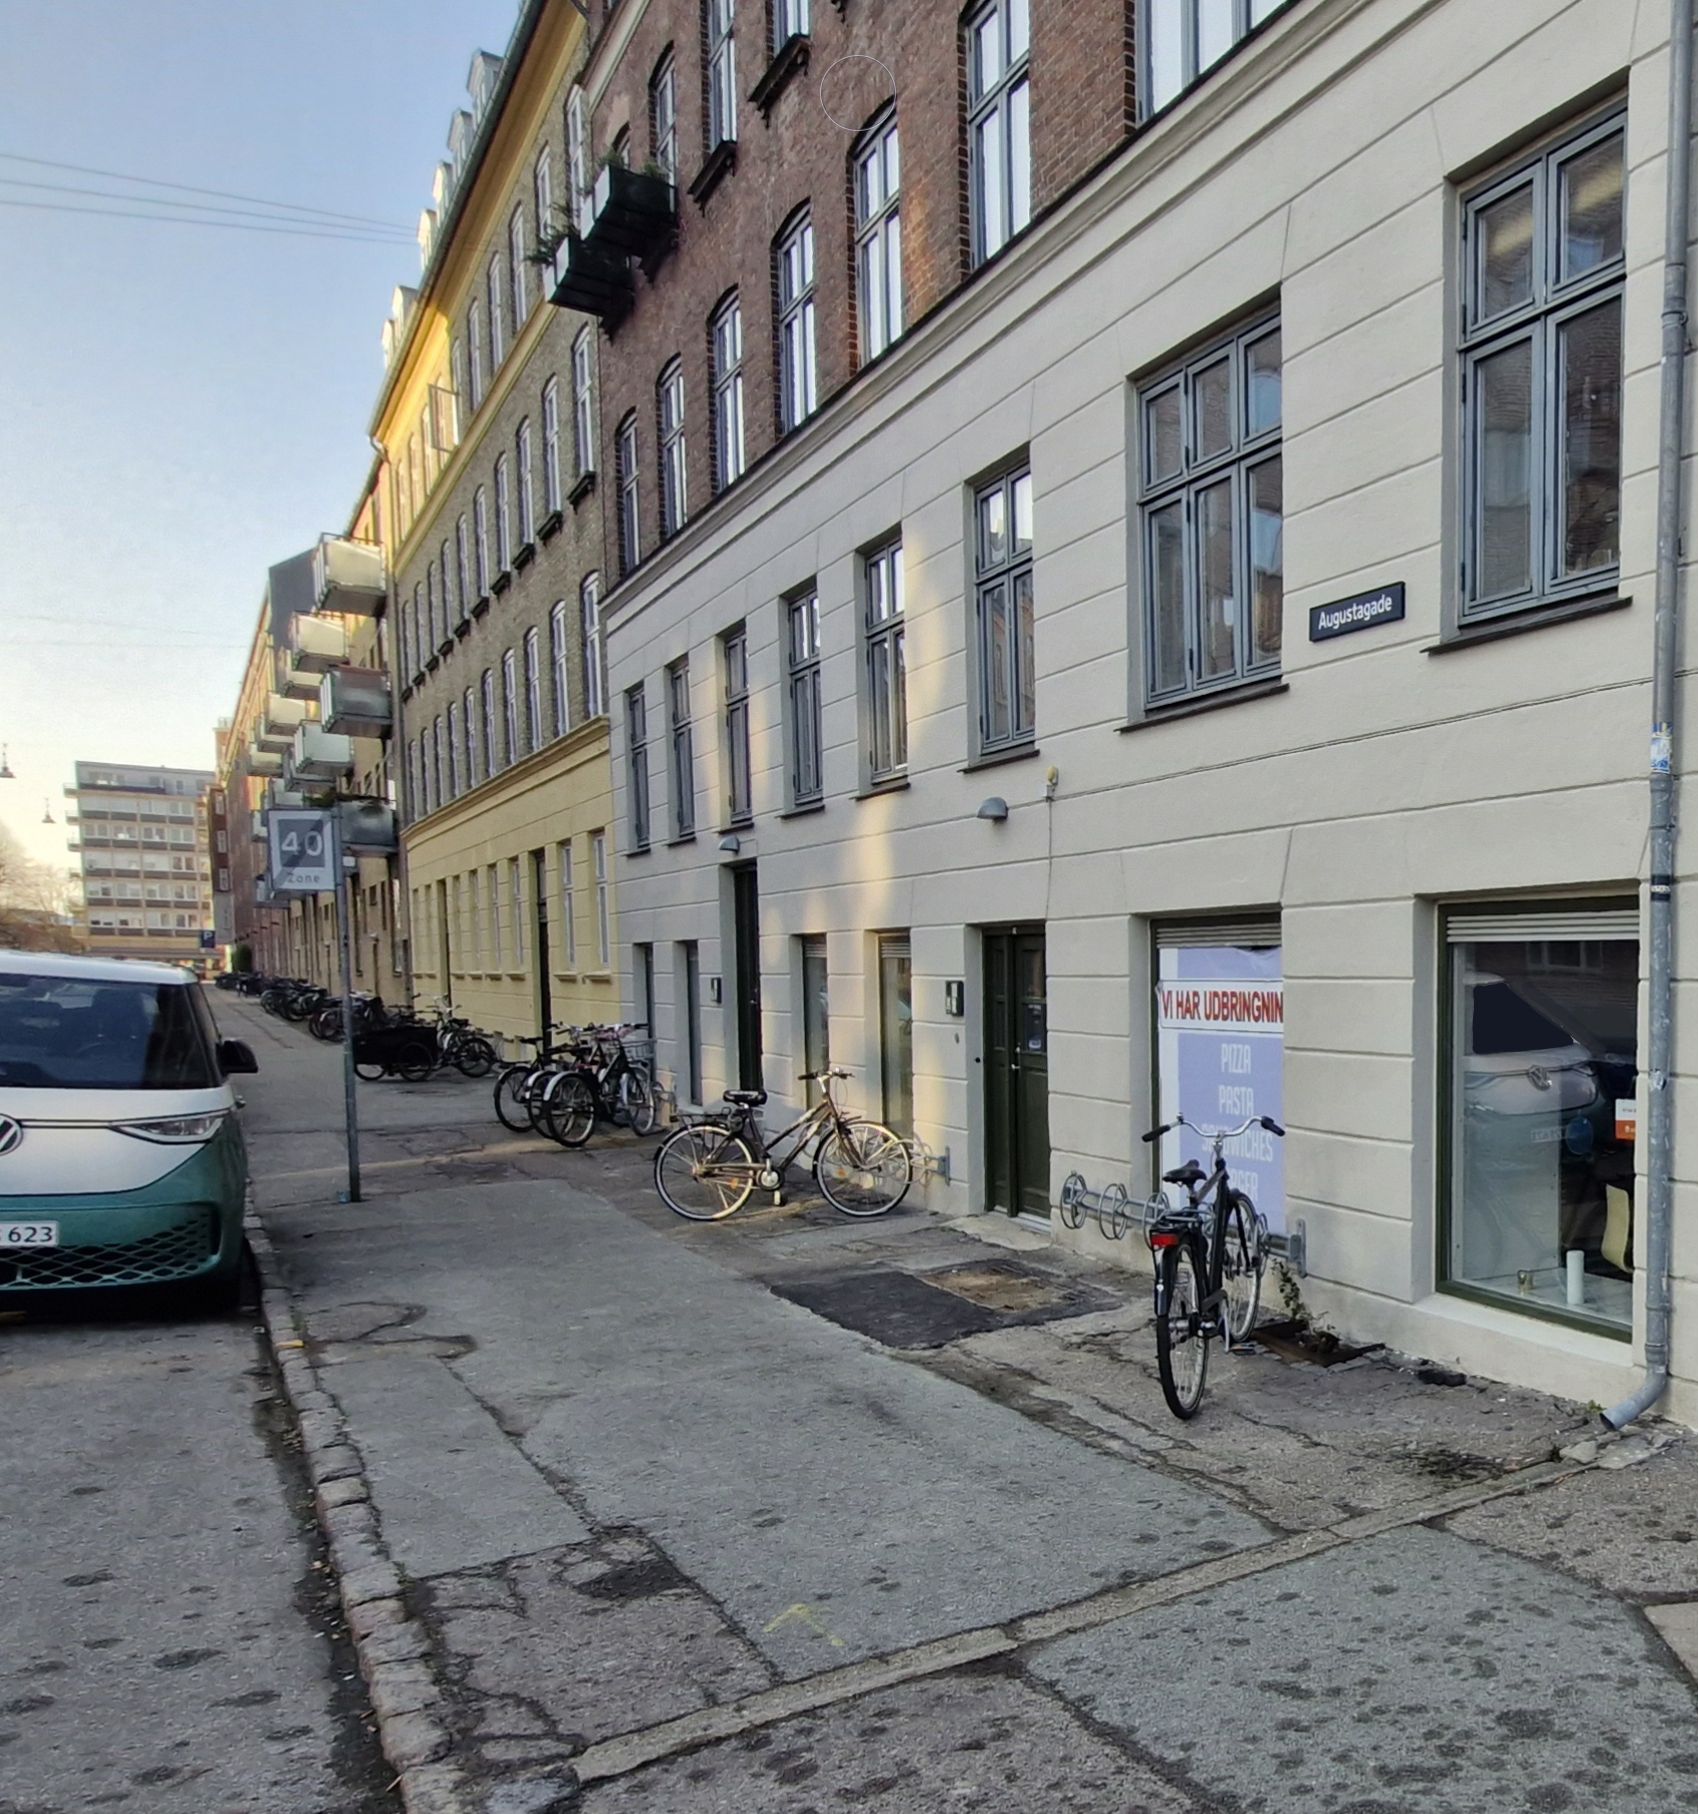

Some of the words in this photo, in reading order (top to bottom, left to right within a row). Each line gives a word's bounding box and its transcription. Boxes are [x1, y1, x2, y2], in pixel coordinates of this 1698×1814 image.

[1318, 594, 1392, 630] Augustagade
[281, 831, 322, 856] 40
[287, 872, 320, 883] Zone
[1162, 990, 1173, 1019] VI
[1176, 990, 1201, 1020] HAR
[1221, 1043, 1252, 1074] PIZZA
[1219, 1085, 1255, 1117] PASTA
[8, 1226, 53, 1243] 623
